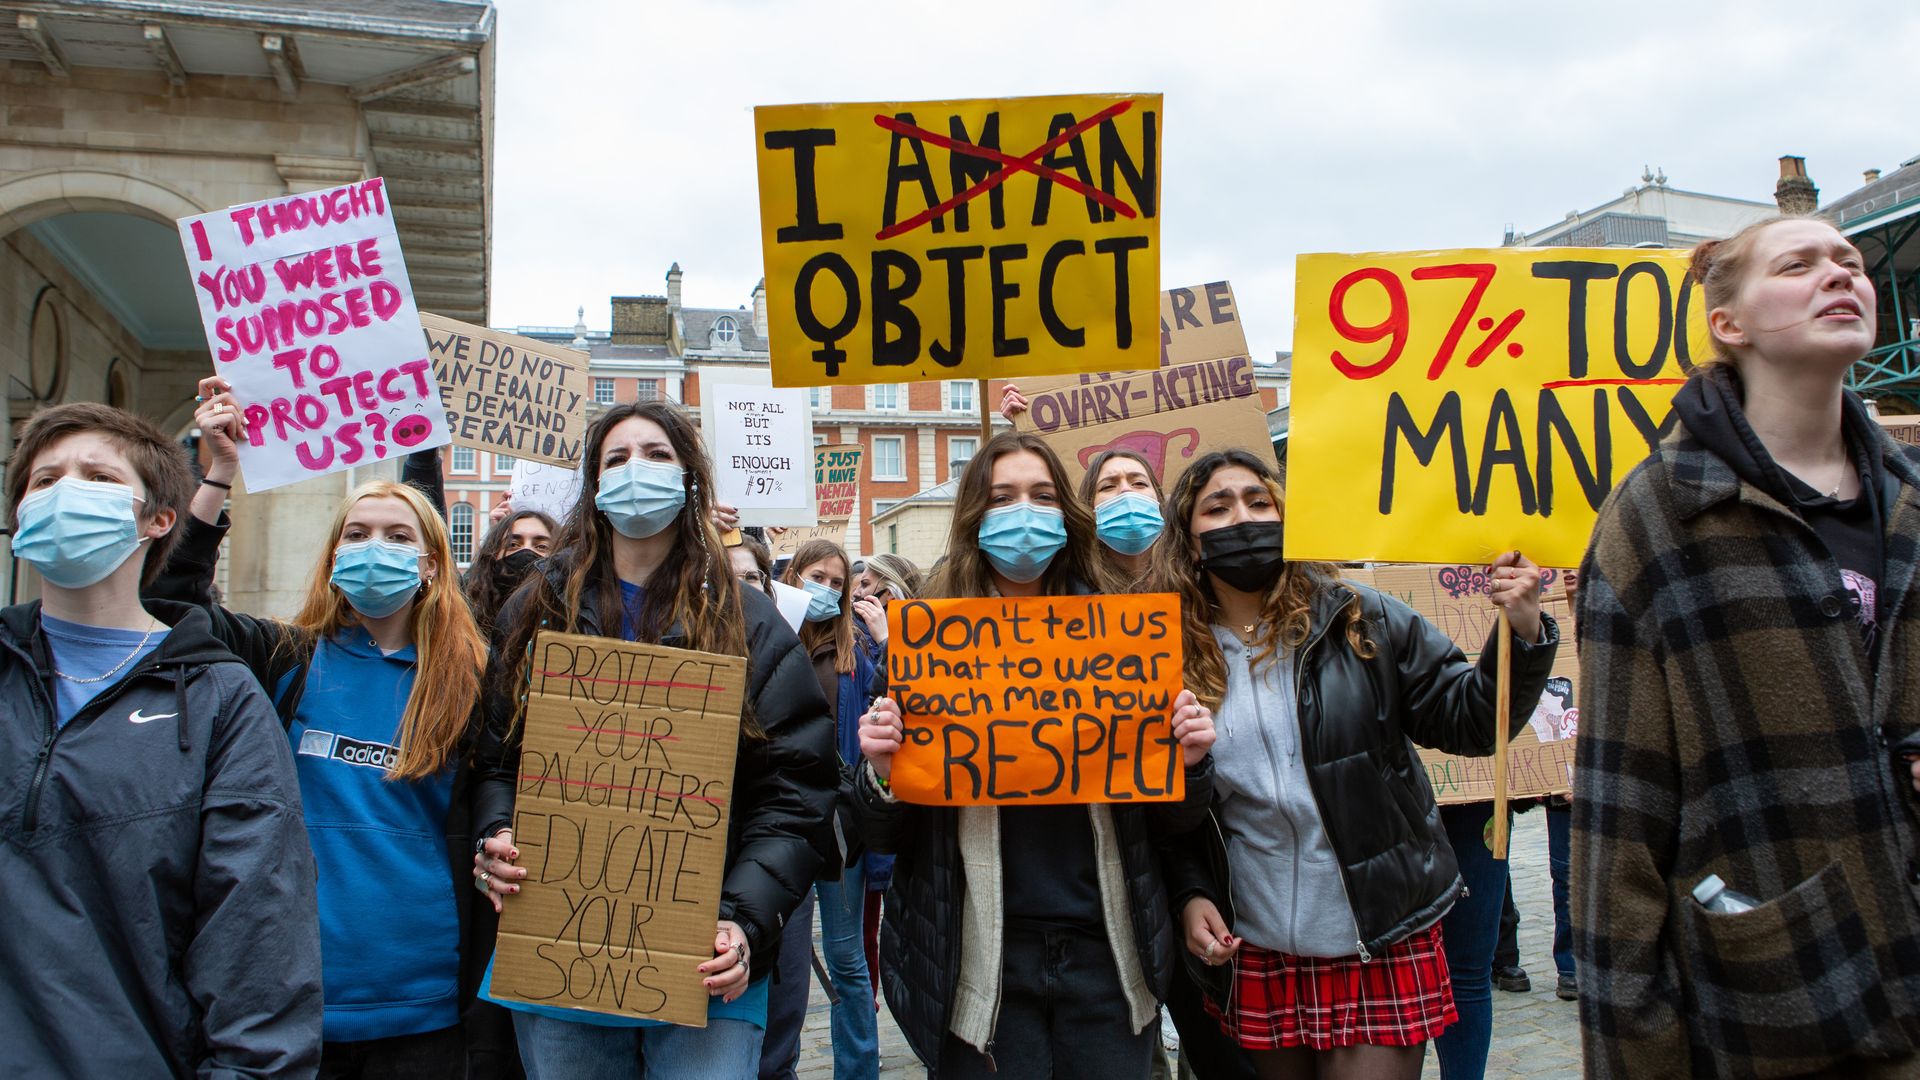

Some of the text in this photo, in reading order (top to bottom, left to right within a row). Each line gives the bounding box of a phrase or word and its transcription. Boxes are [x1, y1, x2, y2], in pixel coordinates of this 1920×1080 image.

[765, 111, 1156, 243] I AM AN
[190, 178, 384, 261] I THOUGHT
[198, 238, 383, 312] YOU WERE
[216, 279, 402, 362] SUPPOSED
[1160, 281, 1235, 334] RE
[1329, 263, 1525, 380] 97%
[272, 344, 341, 388] TO
[423, 328, 575, 386] WE DO NOT
[244, 359, 430, 447] PROTECT
[439, 386, 566, 433] E DEMAND
[729, 401, 784, 414] NOT ALL
[744, 417, 770, 429] BUT
[1031, 357, 1254, 432] OVARY-ACTING
[296, 412, 388, 471] US?
[445, 411, 581, 461] BERATION
[732, 456, 790, 470] ENOUGH
[746, 434, 771, 446] IT'S
[827, 451, 861, 467] JUST
[828, 468, 856, 483] HAVE
[809, 525, 840, 538] WITH
[901, 600, 1168, 651] Don't tell us
[540, 642, 730, 720] PROTECT
[997, 654, 1042, 680] to
[1054, 652, 1171, 684] wear
[889, 684, 993, 716] Teach
[343, 745, 398, 769] adida
[574, 706, 673, 769] YOUR
[942, 713, 1180, 800] RESPECT
[519, 750, 724, 829] DAUGHTERS
[513, 810, 712, 904] EDUCATE
[555, 888, 654, 963] YOUR
[513, 943, 667, 1013] SONS
